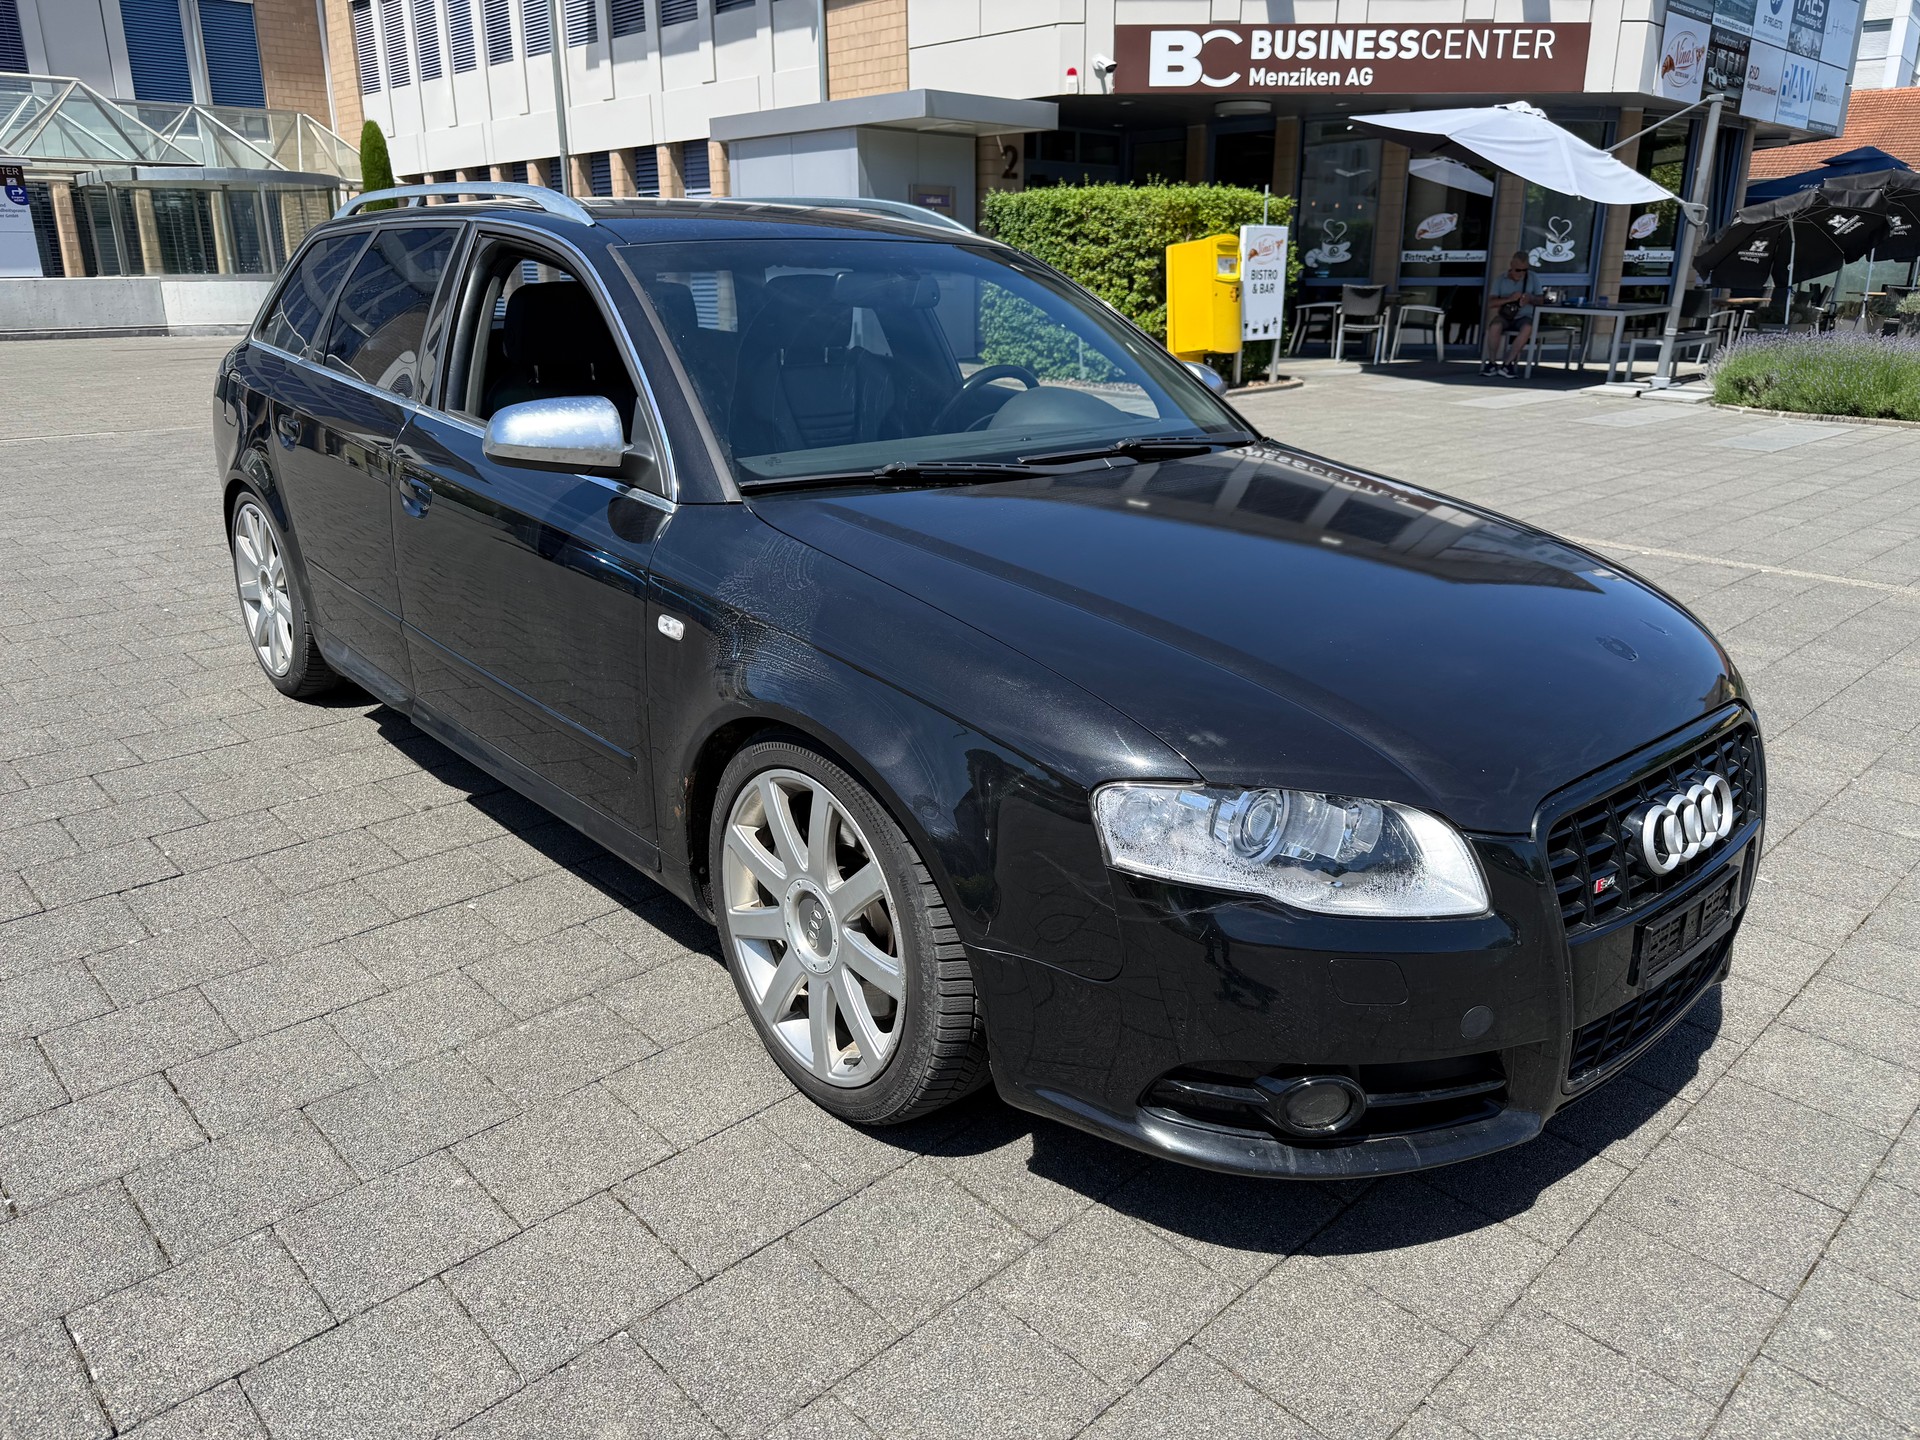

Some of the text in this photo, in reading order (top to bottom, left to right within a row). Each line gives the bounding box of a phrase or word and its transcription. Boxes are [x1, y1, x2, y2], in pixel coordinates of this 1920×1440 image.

[1250, 28, 1556, 60] BUSINESSCENTER
[1148, 29, 1242, 88] BC
[1248, 67, 1374, 87] Menziken AG
[1002, 145, 1018, 179] 2
[1251, 269, 1278, 281] BISTRO
[1252, 283, 1275, 295] & BAR
